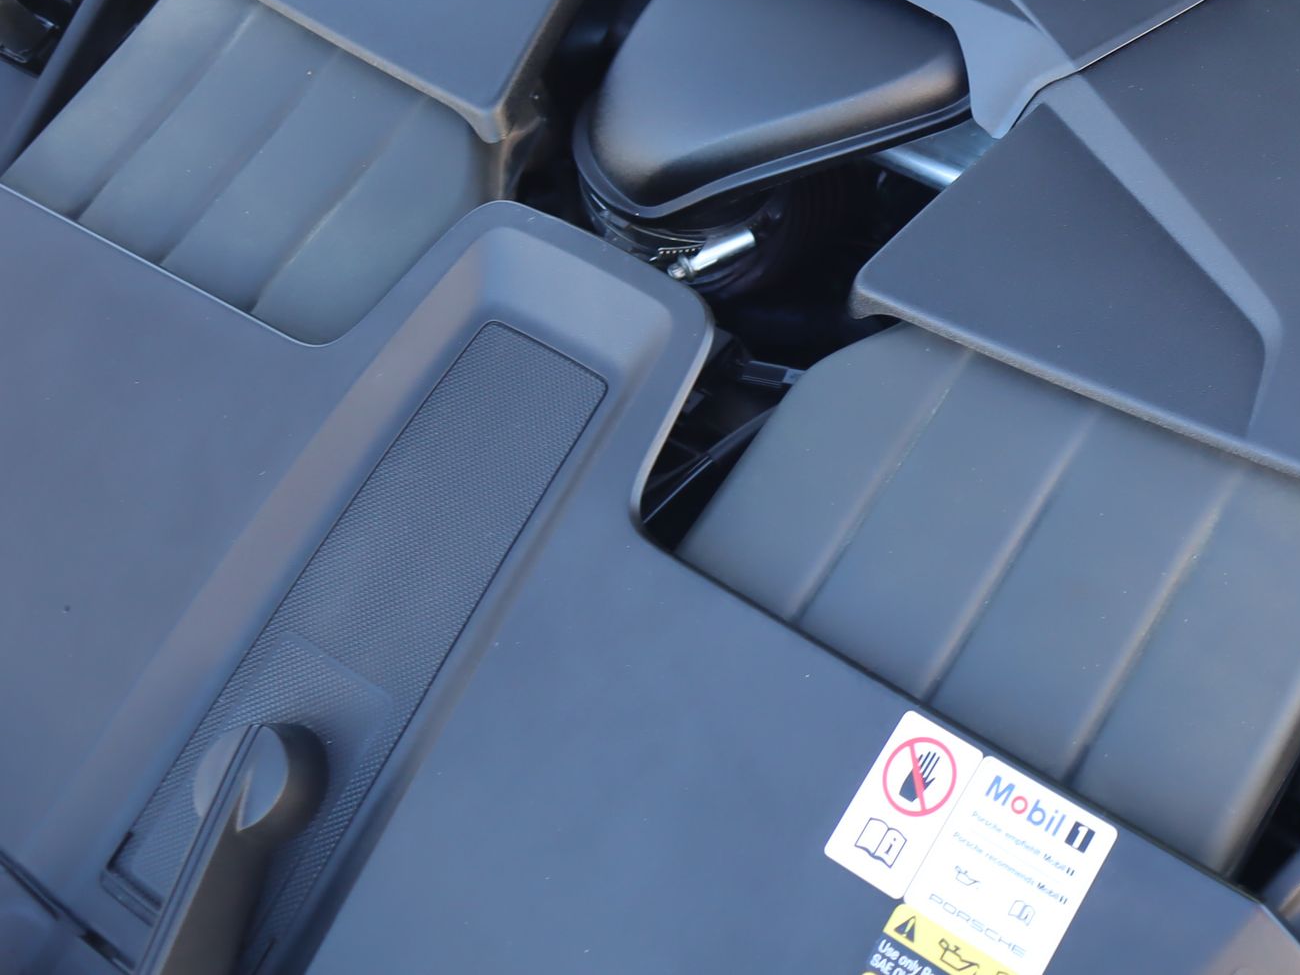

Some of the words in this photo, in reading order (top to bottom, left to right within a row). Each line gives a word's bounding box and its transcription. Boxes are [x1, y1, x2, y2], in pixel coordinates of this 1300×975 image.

[985, 775, 1067, 837] Mobil
[928, 893, 1028, 959] PORSCHE
[870, 953, 895, 975] SAE
[877, 939, 900, 961] Use
[898, 955, 923, 974] only
